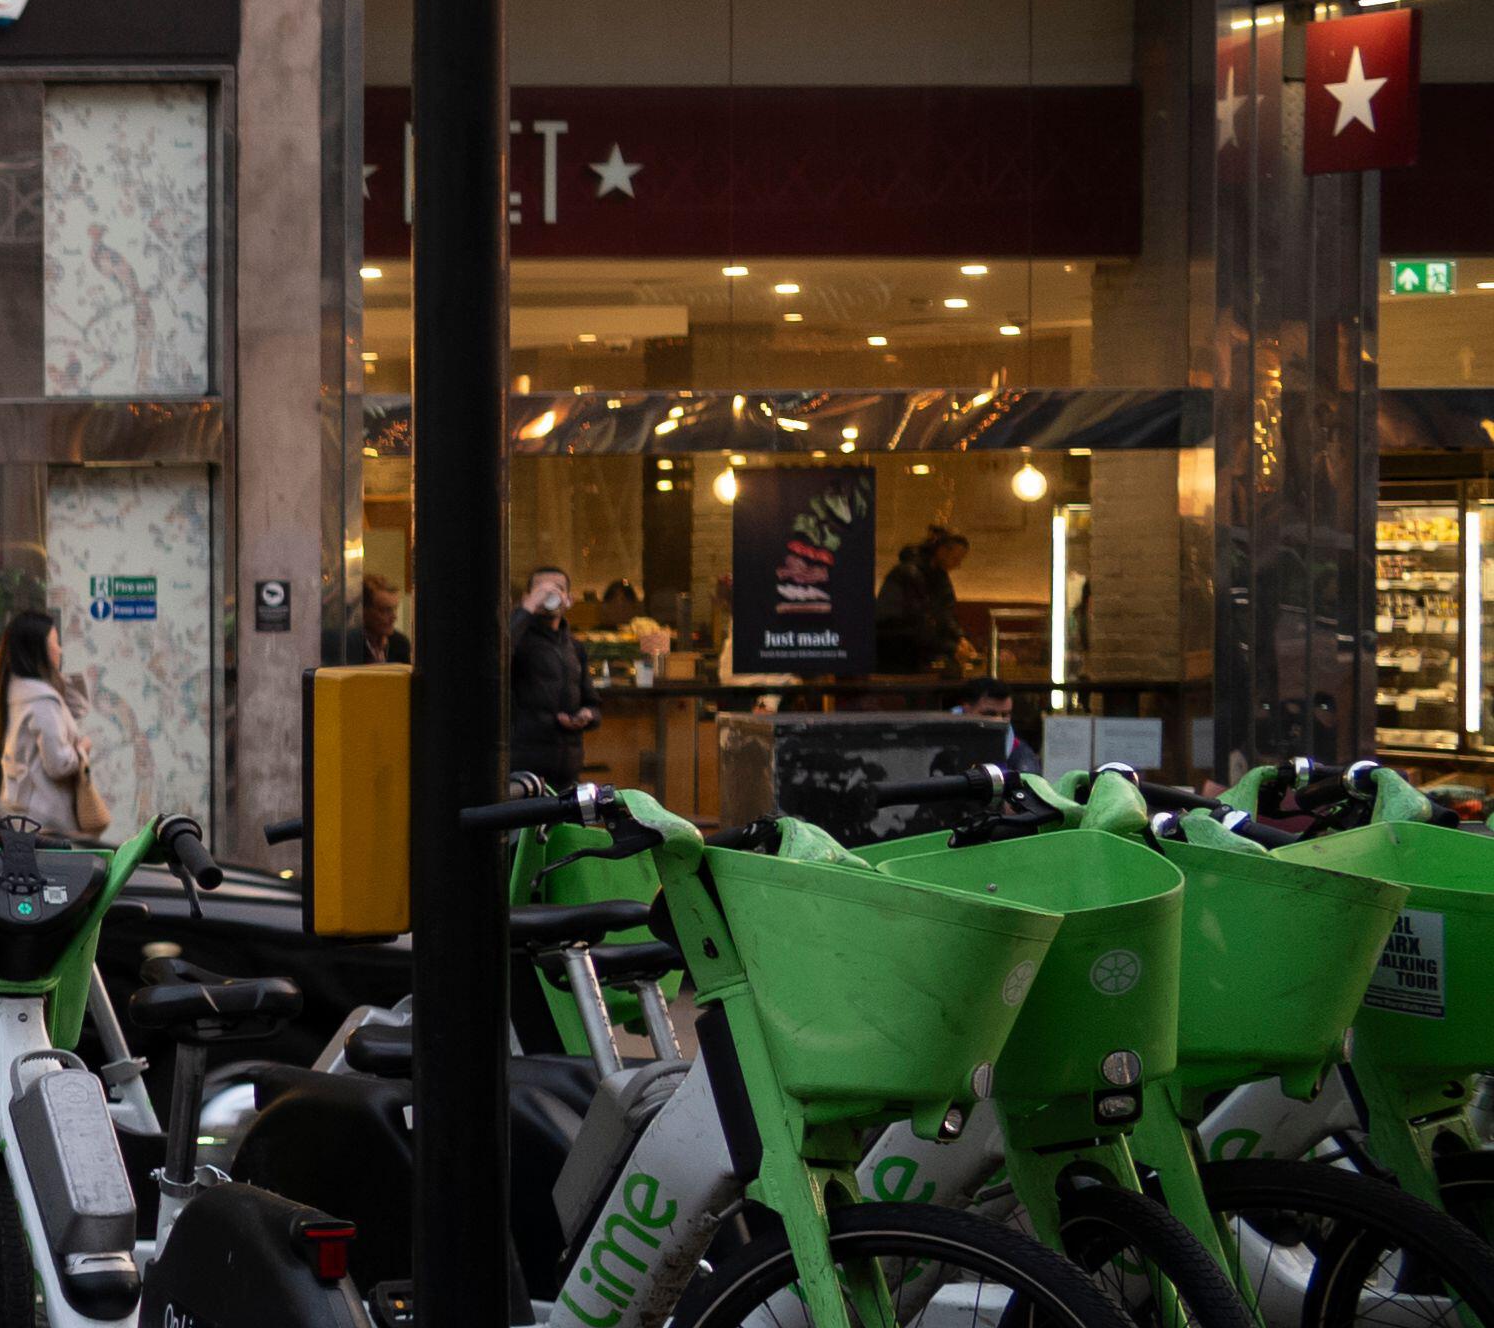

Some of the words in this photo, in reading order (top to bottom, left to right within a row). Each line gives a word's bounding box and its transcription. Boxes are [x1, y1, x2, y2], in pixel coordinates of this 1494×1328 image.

[764, 630, 794, 648] Just
[797, 629, 839, 647] made
[1384, 935, 1421, 956] ARX
[1378, 953, 1438, 975] ALKING
[1397, 971, 1438, 991] TOUR
